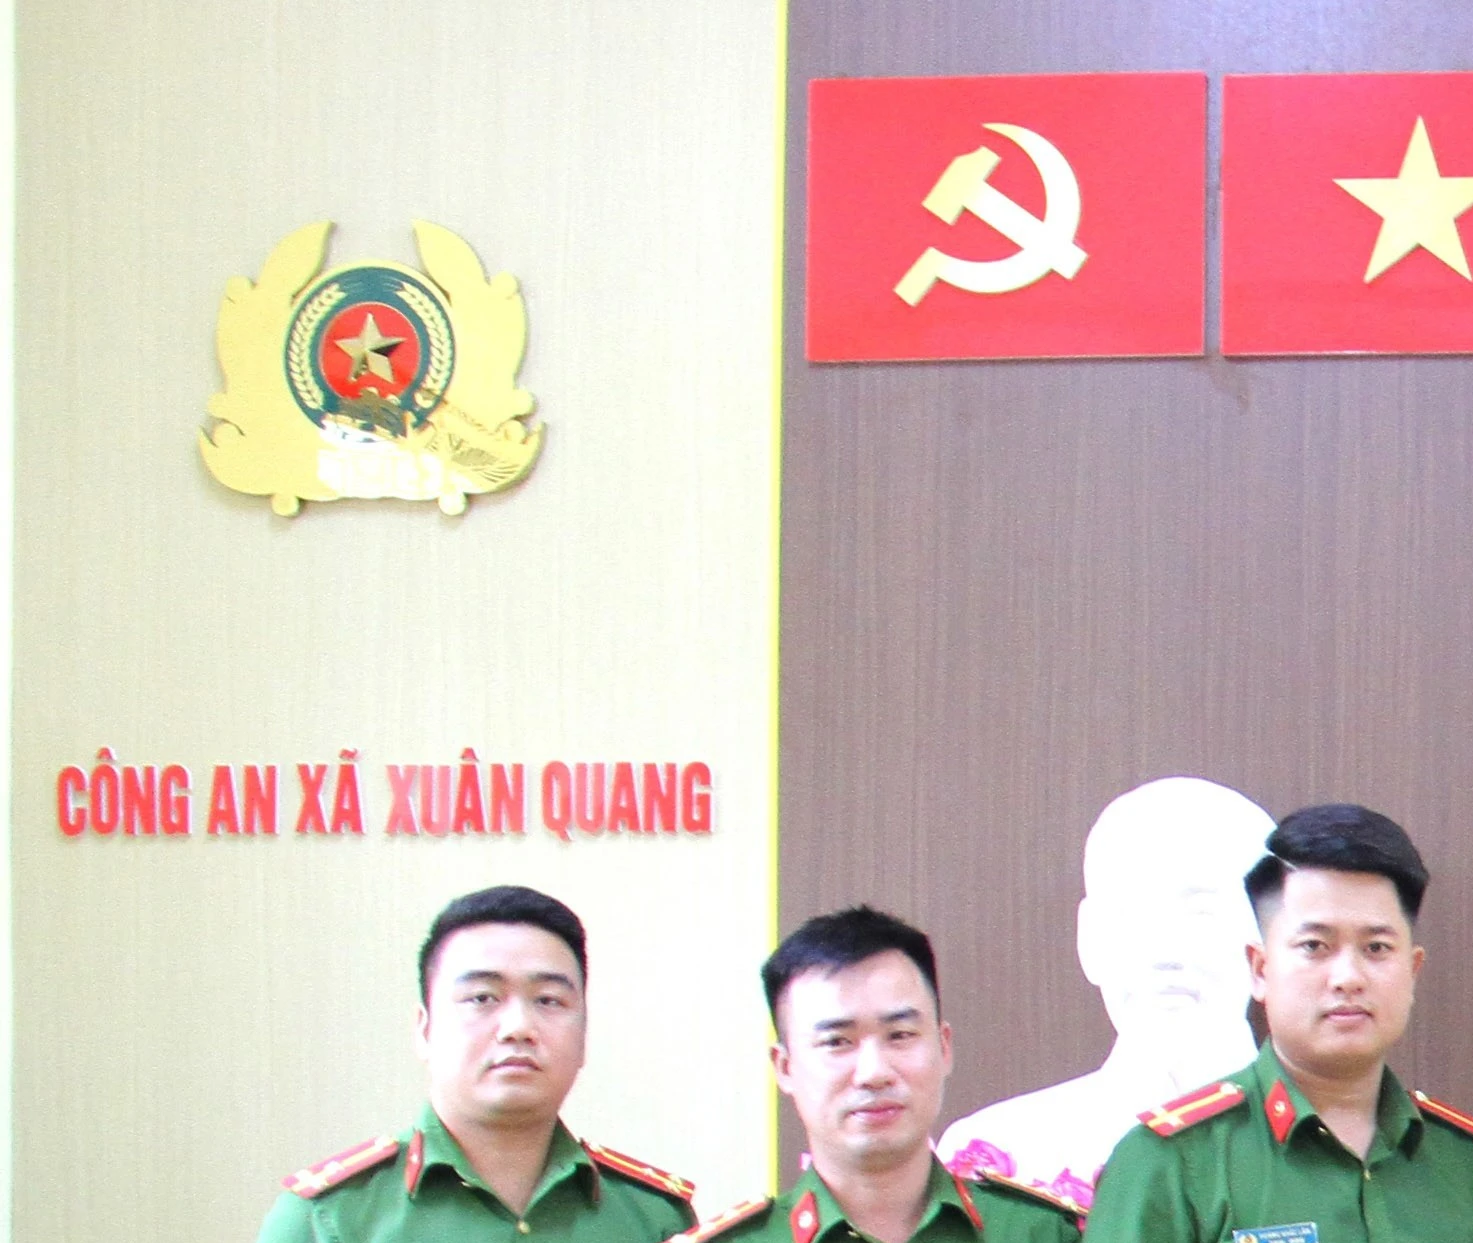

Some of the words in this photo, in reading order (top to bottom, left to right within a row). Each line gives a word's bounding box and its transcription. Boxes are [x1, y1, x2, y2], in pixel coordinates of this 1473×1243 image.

[56, 747, 192, 837] CÔNG
[207, 763, 280, 836] AN
[295, 748, 365, 836] XÃ
[385, 747, 526, 836] XUÂN
[541, 760, 713, 842] QUANG
